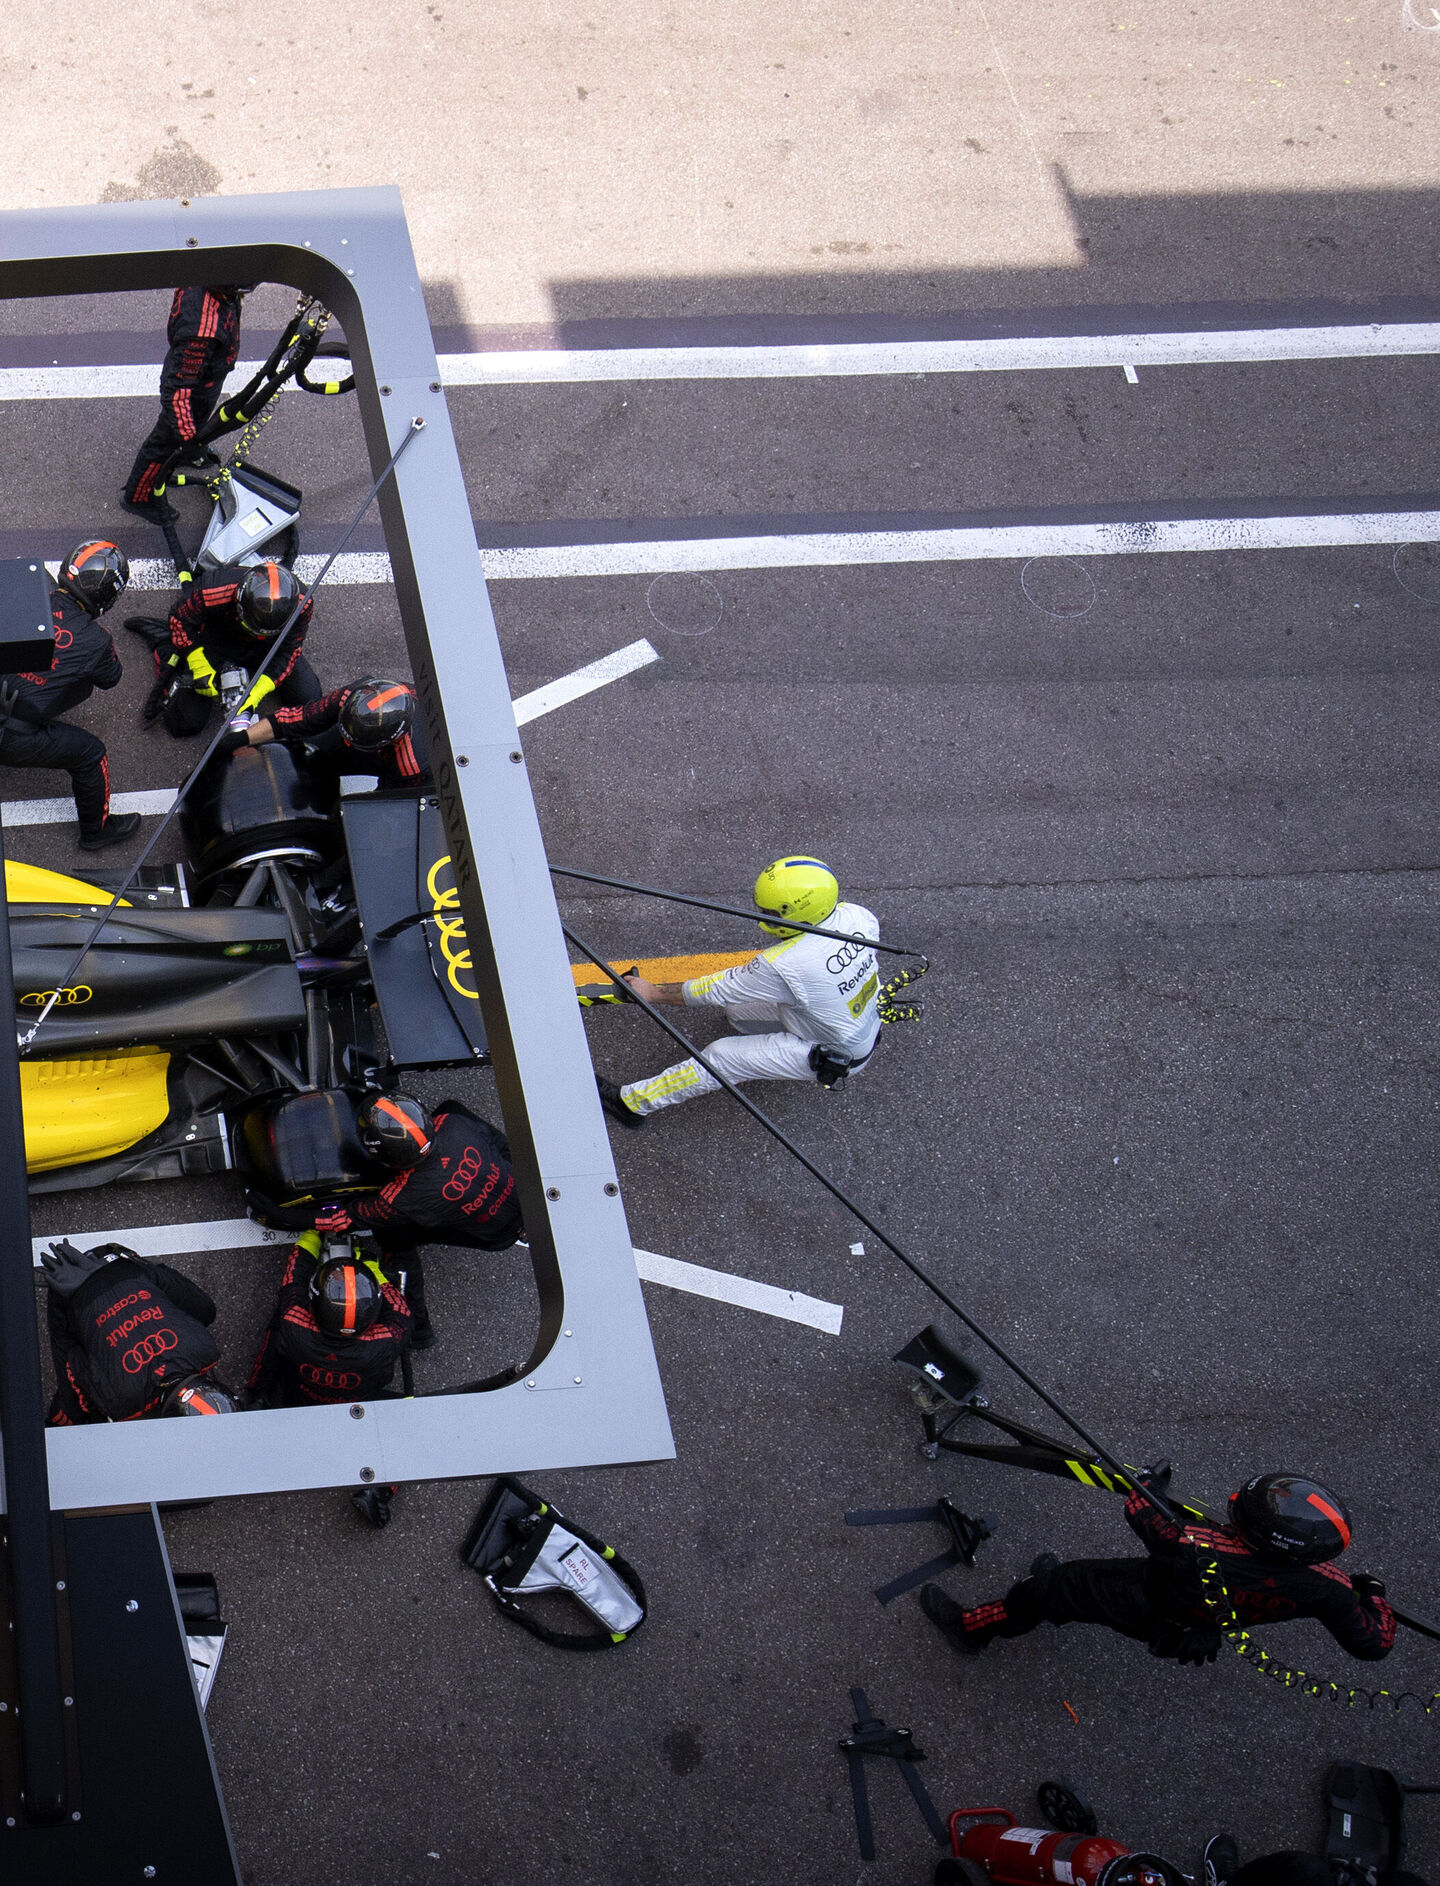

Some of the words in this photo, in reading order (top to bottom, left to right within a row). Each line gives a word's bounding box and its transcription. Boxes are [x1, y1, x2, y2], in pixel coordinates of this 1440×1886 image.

[837, 953, 875, 995] Revolut
[462, 1162, 500, 1215] Revolut
[262, 1231, 276, 1241] 30
[96, 1293, 138, 1328] Castrol
[105, 1305, 165, 1347] Revolut
[565, 1559, 588, 1585] SPARE
[580, 1559, 589, 1571] RL
